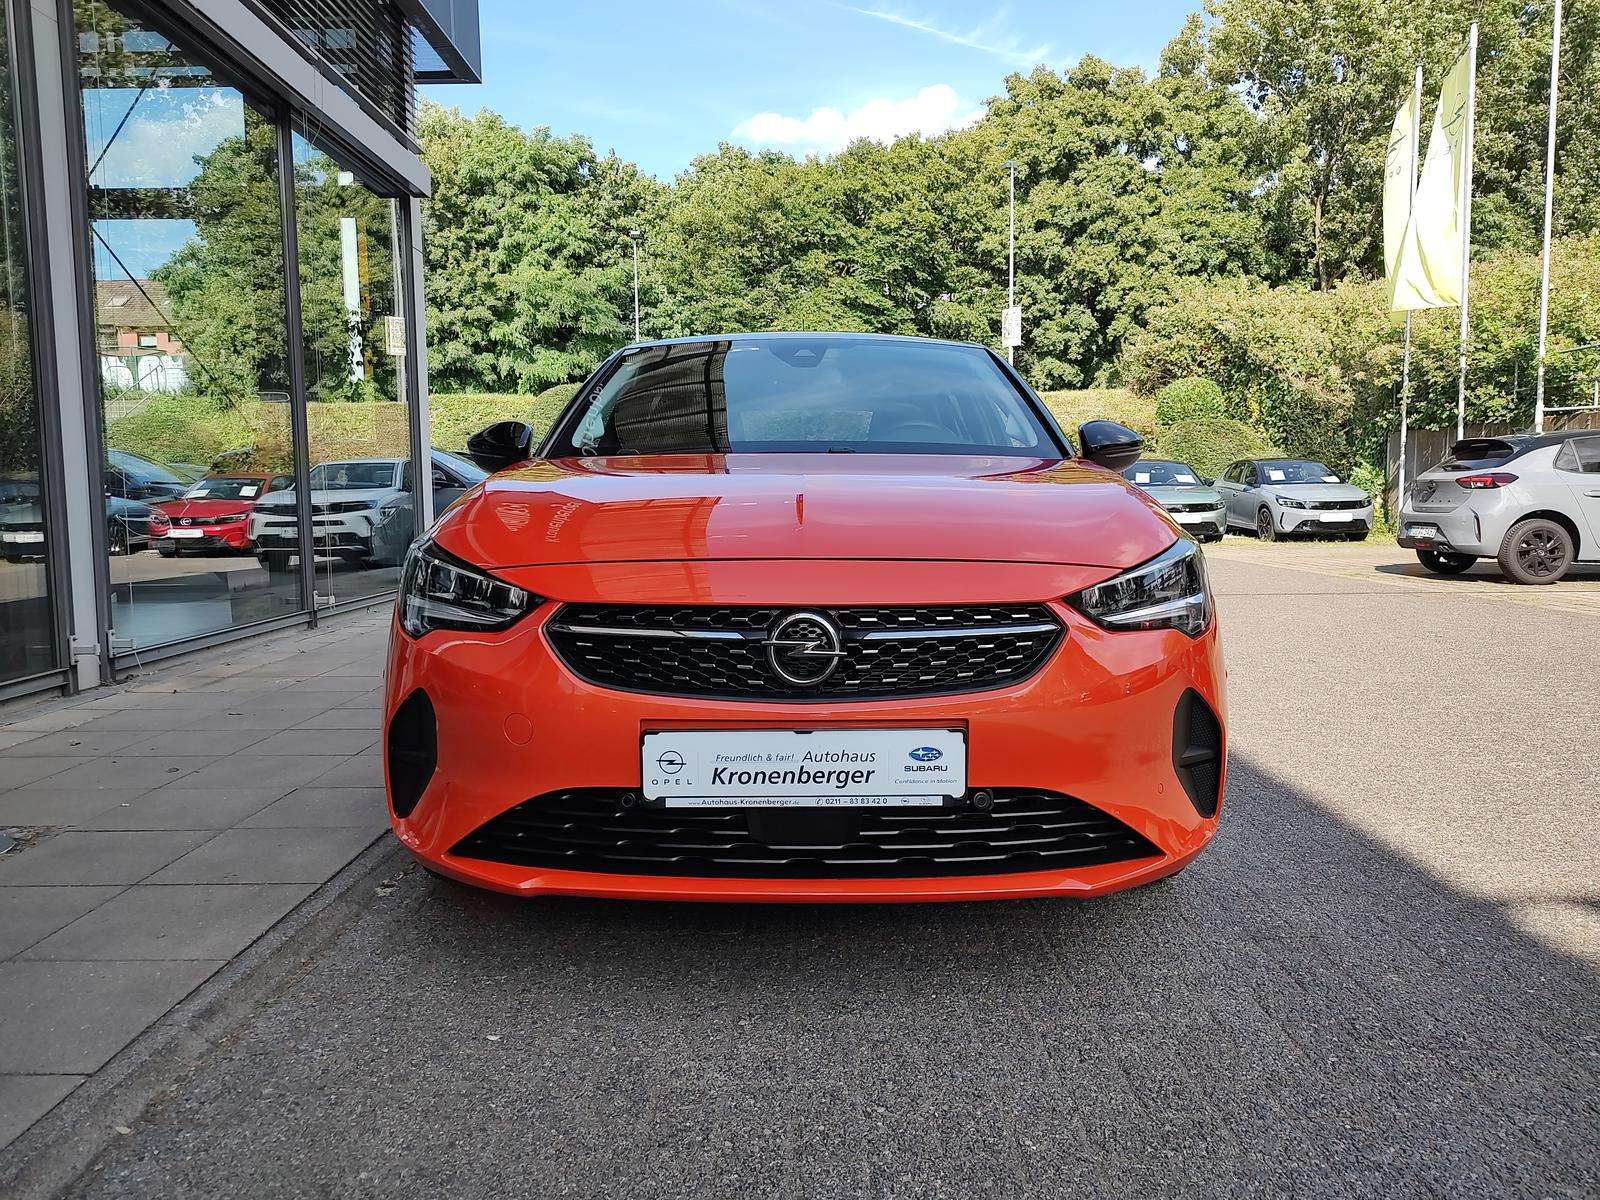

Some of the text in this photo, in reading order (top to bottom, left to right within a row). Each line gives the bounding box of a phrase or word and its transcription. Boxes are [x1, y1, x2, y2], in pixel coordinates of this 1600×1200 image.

[715, 754, 763, 762] Freundlich
[775, 754, 795, 763] fair!
[801, 750, 876, 763] Autohaus
[711, 765, 875, 789] Kronenberger
